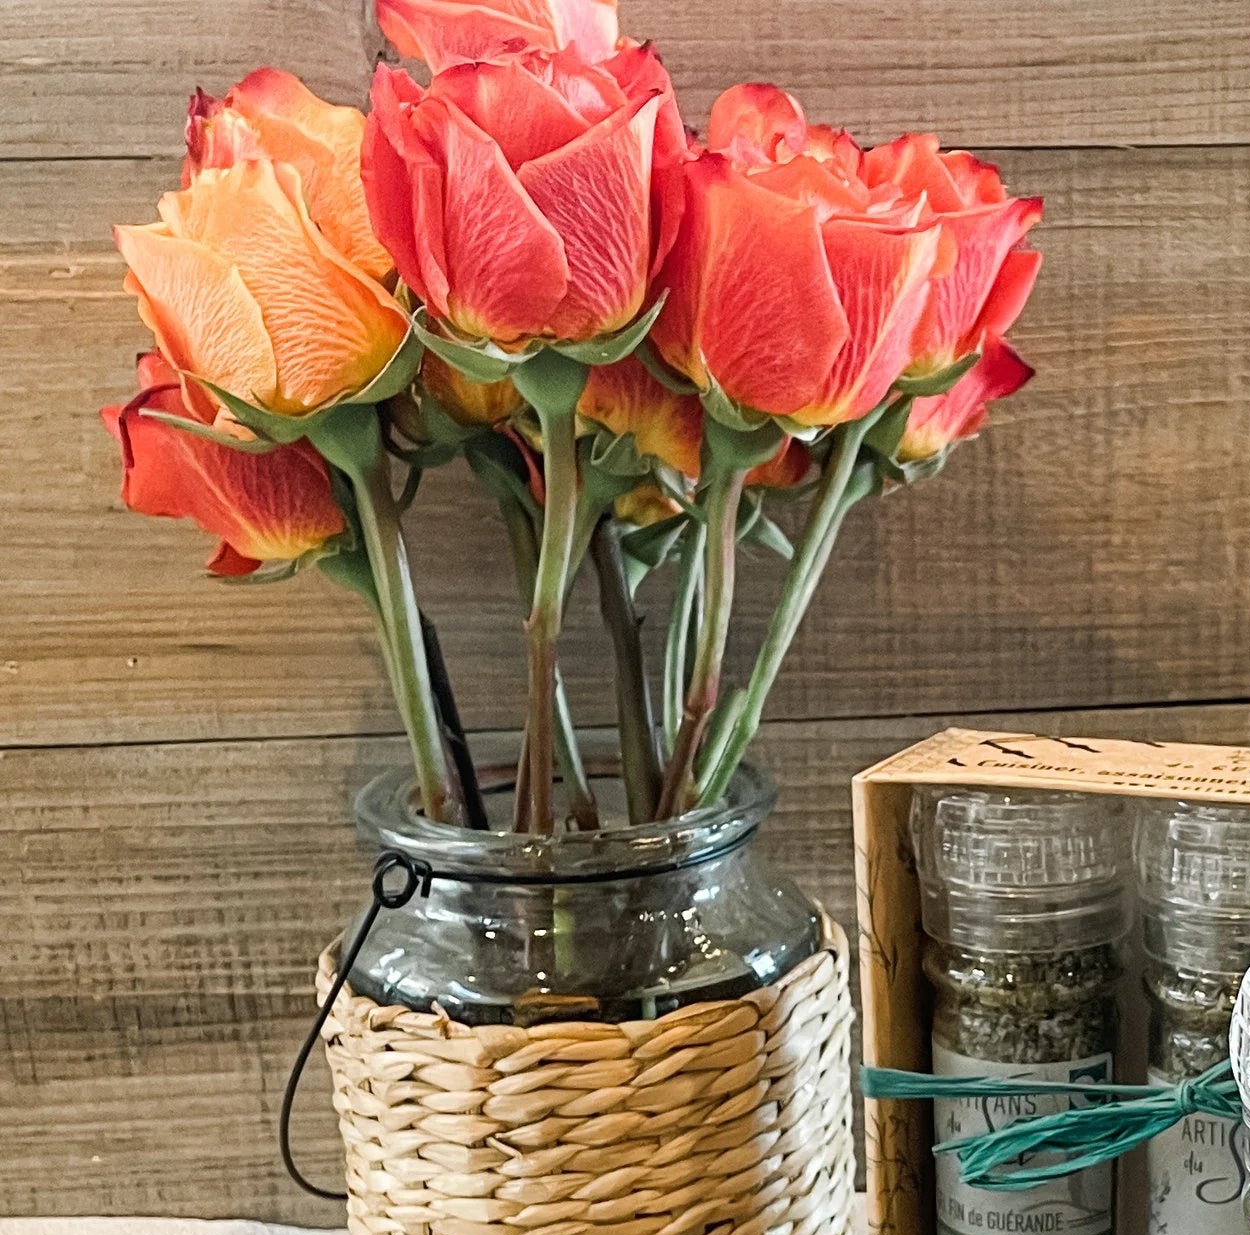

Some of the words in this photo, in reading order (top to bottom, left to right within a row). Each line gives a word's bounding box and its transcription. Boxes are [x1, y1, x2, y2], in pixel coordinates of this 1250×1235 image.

[1184, 1151, 1203, 1176] du
[968, 1209, 984, 1227] de
[987, 1206, 1064, 1233] GUÉRANDE
